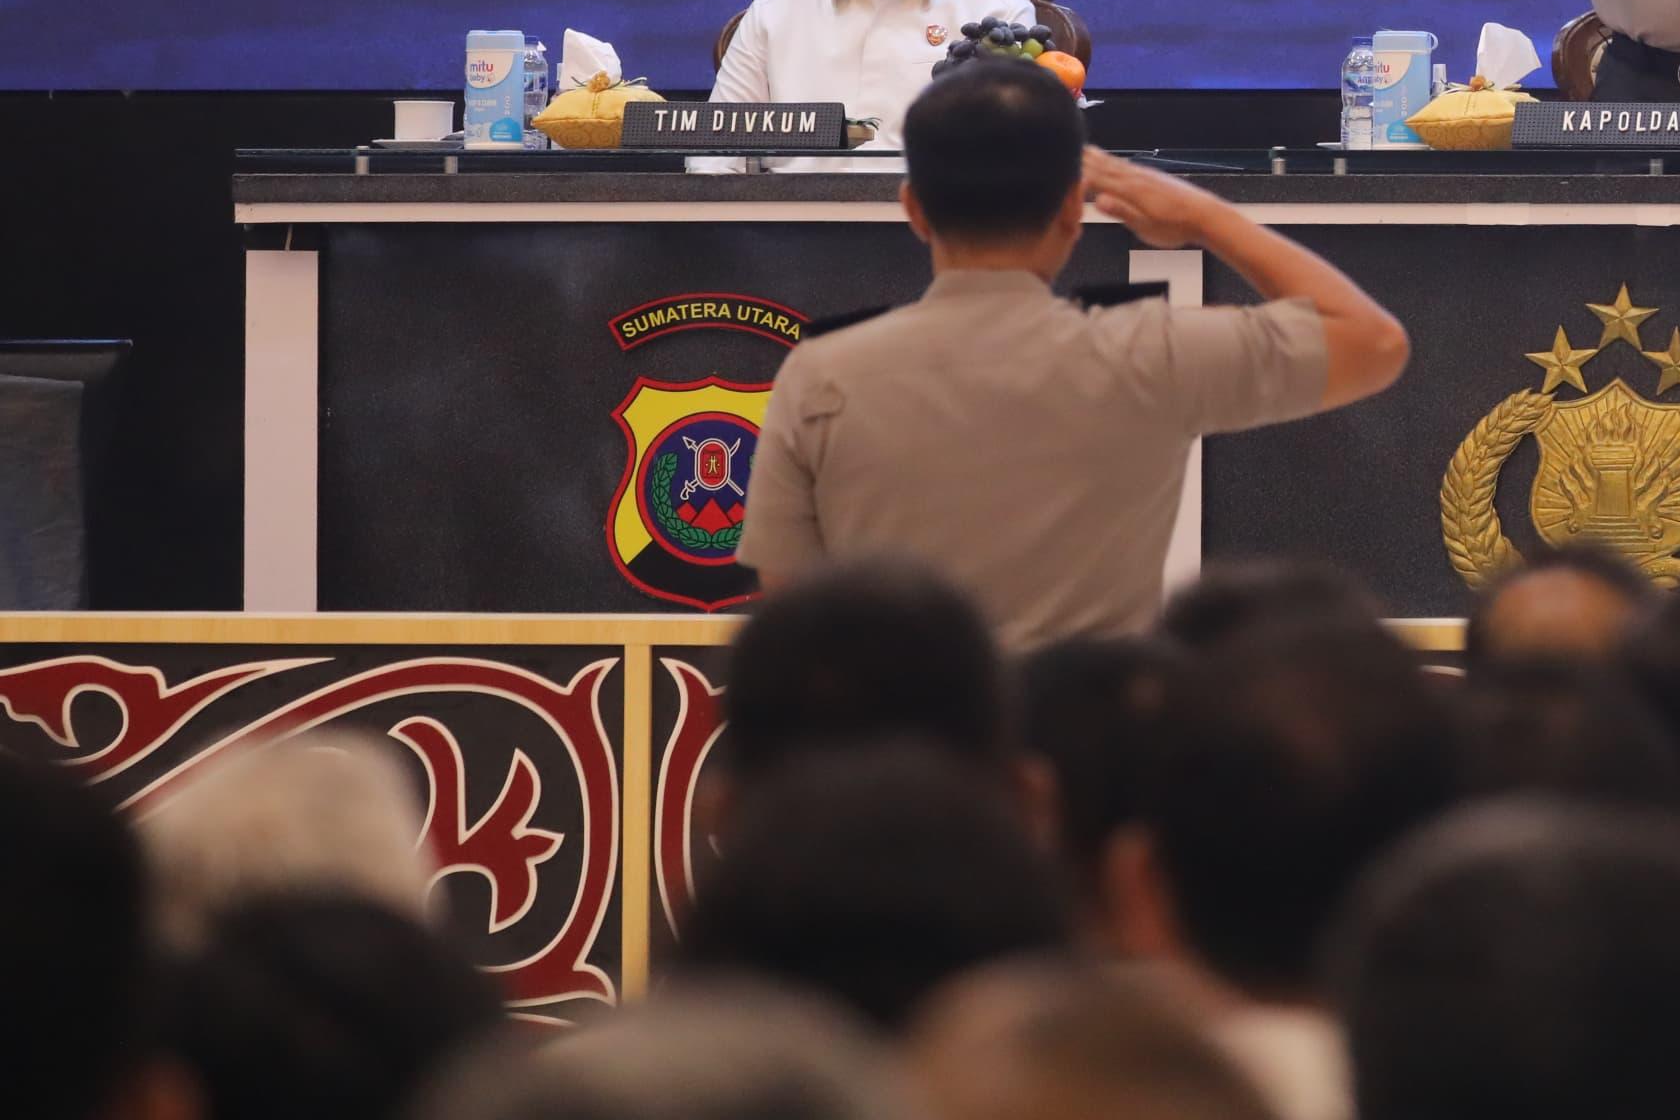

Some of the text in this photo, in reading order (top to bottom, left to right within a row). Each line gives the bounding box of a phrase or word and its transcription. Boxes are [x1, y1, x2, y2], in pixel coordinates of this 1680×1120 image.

[470, 60, 494, 72] mitu
[1374, 61, 1390, 73] itu
[655, 110, 816, 132] TIM DIVKUM
[1562, 110, 1680, 132] KAPOLDA
[622, 302, 801, 340] SUMATERA UTARA
